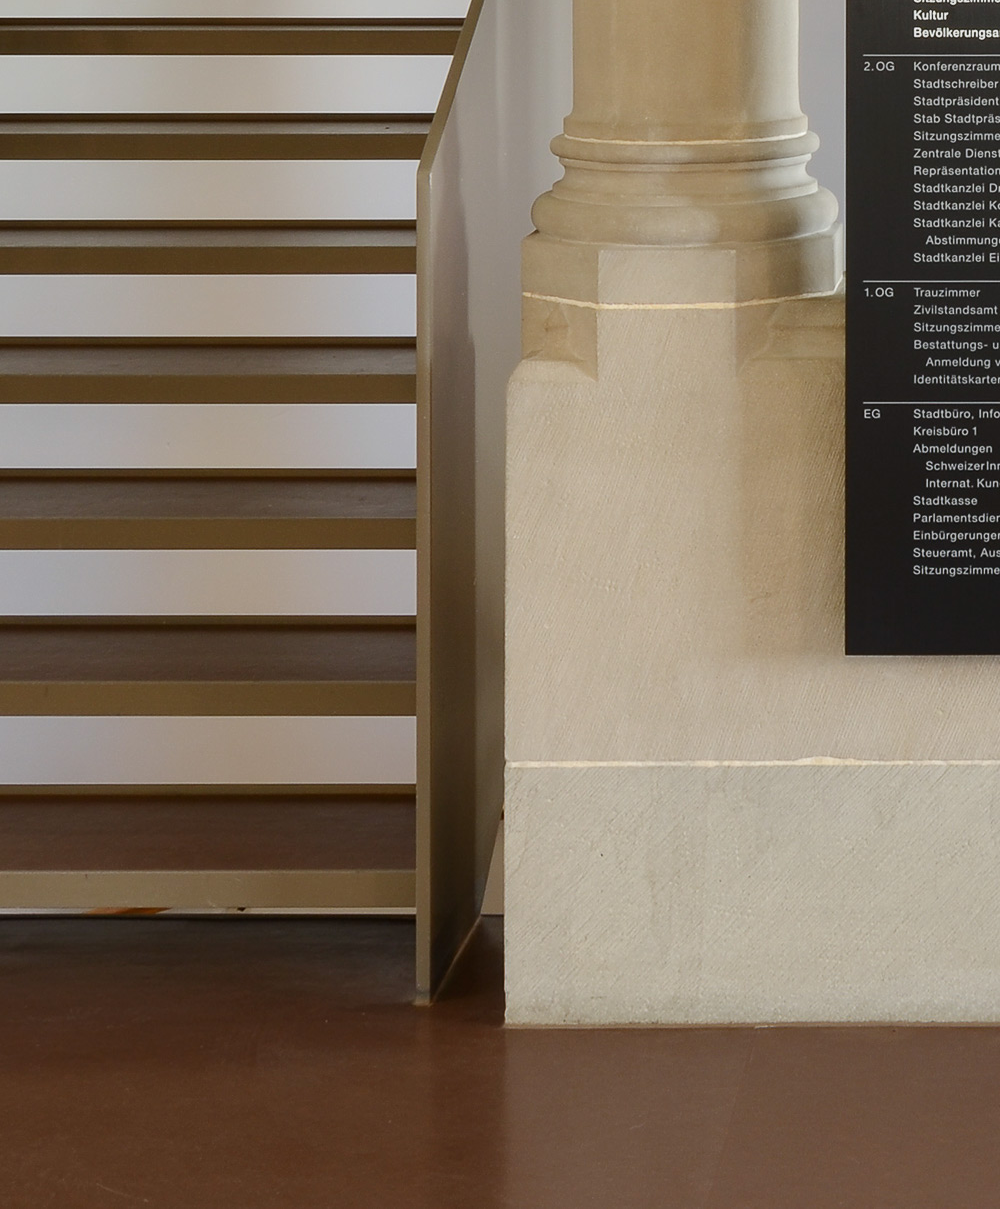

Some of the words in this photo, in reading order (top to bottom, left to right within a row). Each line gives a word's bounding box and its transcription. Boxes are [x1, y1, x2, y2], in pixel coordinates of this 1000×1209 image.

[913, 10, 950, 21] Kultur
[913, 79, 1000, 89] Stadtschreiber
[913, 113, 941, 124] Stab
[912, 148, 962, 159] Zentrale
[913, 183, 985, 194] Stadtkanzlei
[913, 200, 986, 211] Stadtkanzlei
[912, 218, 985, 229] Stadtkanzlei
[912, 253, 985, 263] Stadtkanzlei
[913, 287, 981, 298] Trauzimmer
[913, 305, 999, 316] Zivilstandsamt
[913, 340, 989, 353] Bestattungs-
[925, 357, 991, 370] Anmeldung
[863, 409, 881, 420] EG
[912, 409, 975, 421] Stadtbüro,
[913, 426, 970, 437] Kreisbüro
[971, 427, 977, 436] 1
[912, 444, 993, 456] Abmeldungen
[925, 478, 974, 489] Internat.
[912, 496, 978, 506] Stadtkasse
[912, 548, 977, 559] Steueramt,
